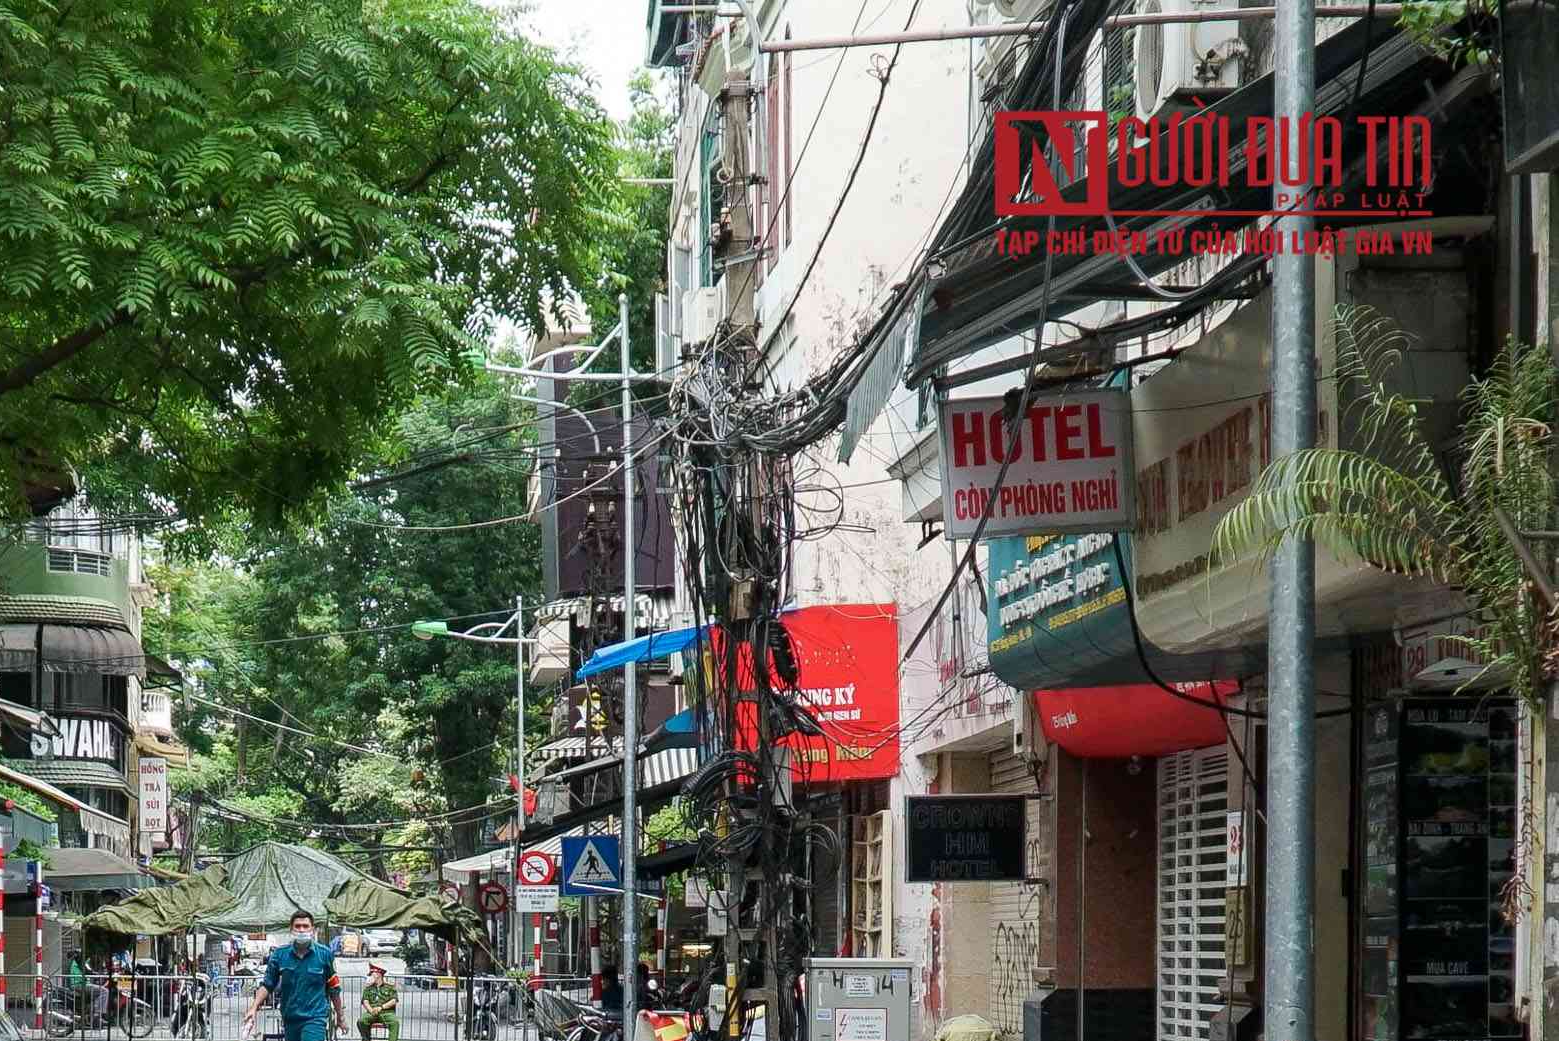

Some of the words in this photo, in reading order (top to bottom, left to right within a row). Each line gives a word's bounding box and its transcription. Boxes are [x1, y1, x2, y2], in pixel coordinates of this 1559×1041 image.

[952, 403, 1116, 467] HOTEL
[955, 482, 996, 520] CÒN
[1001, 479, 1067, 518] PHÒNG
[1071, 468, 1119, 513] NGHỈ
[834, 682, 855, 705] KÝ
